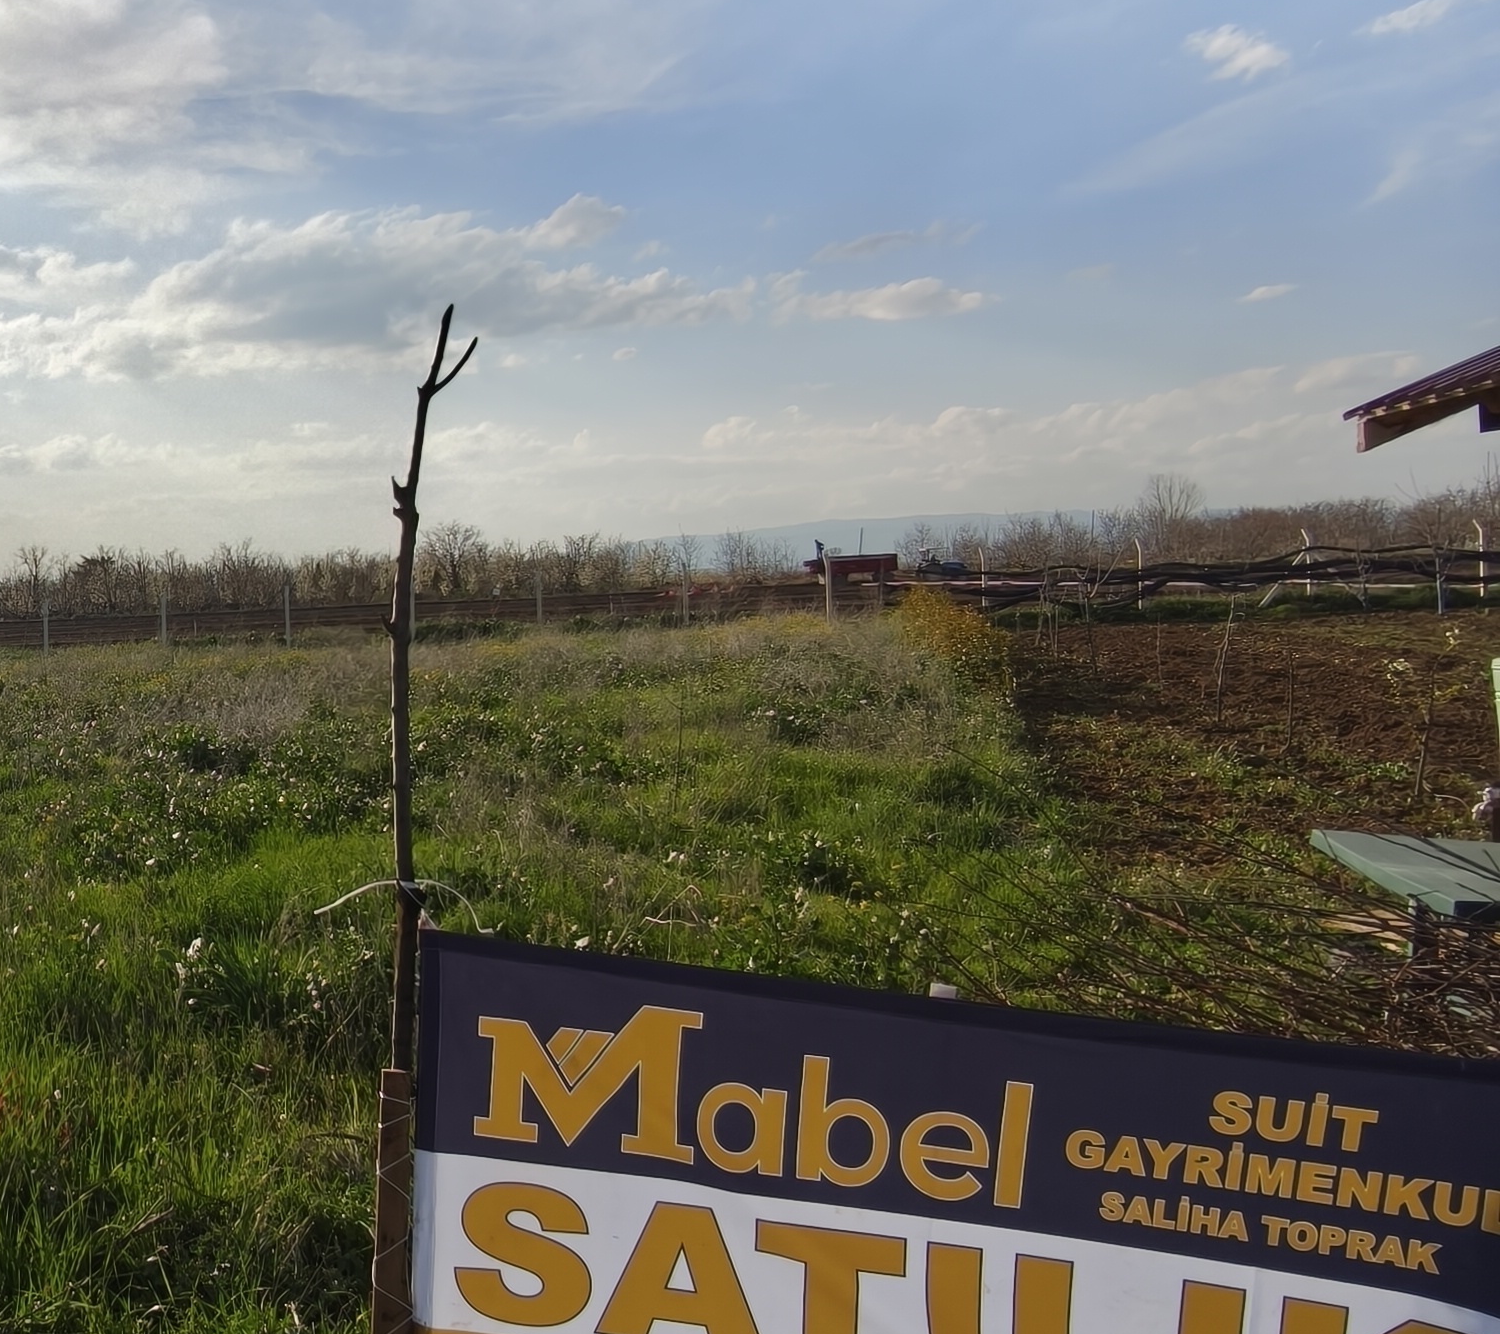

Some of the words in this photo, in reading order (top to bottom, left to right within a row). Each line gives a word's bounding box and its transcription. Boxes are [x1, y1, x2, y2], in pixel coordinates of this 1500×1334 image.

[473, 1004, 1034, 1209] Mabel
[1208, 1091, 1379, 1153] SUİT
[1099, 1191, 1249, 1242] SALİHA
[1261, 1215, 1442, 1275] TOPRAK
